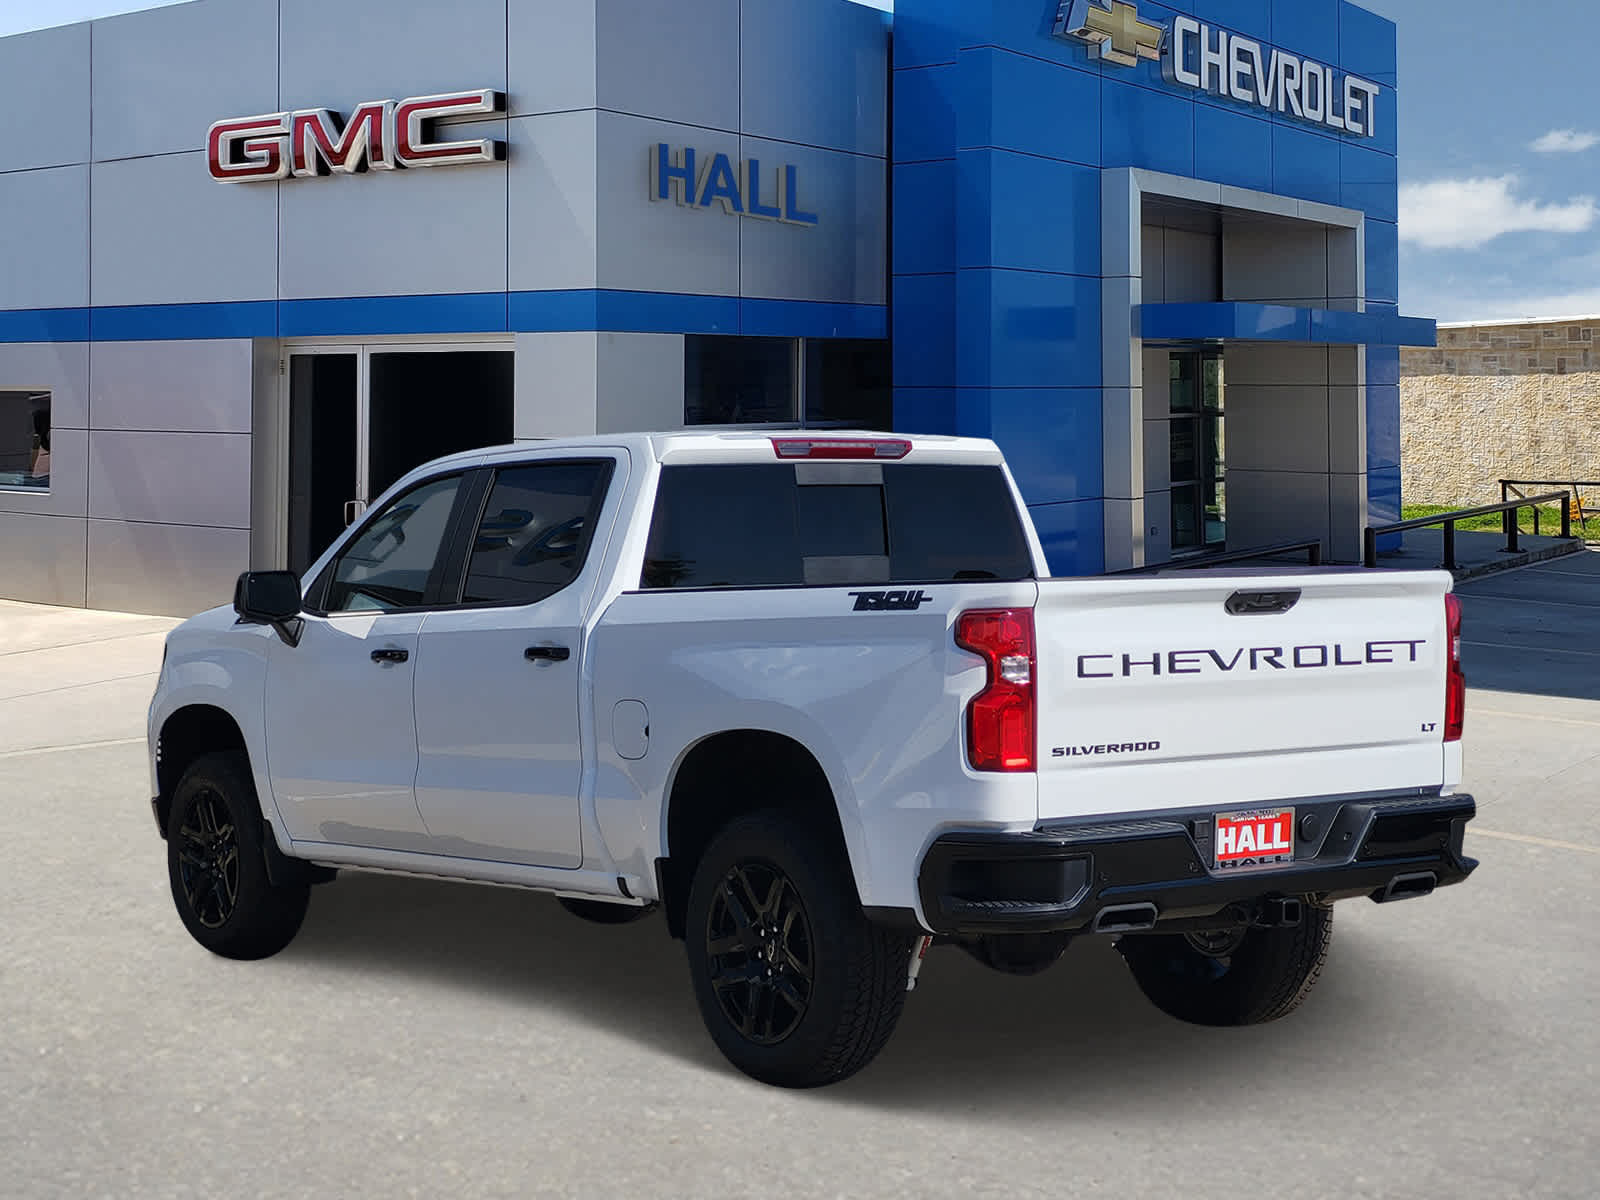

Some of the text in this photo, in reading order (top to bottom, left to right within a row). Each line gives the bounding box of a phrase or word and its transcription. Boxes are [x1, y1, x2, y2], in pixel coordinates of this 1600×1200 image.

[1174, 16, 1379, 137] CHEVROLET
[206, 88, 508, 185] GMC
[651, 142, 818, 228] HALL
[1077, 640, 1426, 678] CHEVROLET
[1421, 723, 1436, 732] LT
[1051, 741, 1161, 757] SILVERADO
[1217, 822, 1289, 854] HALL
